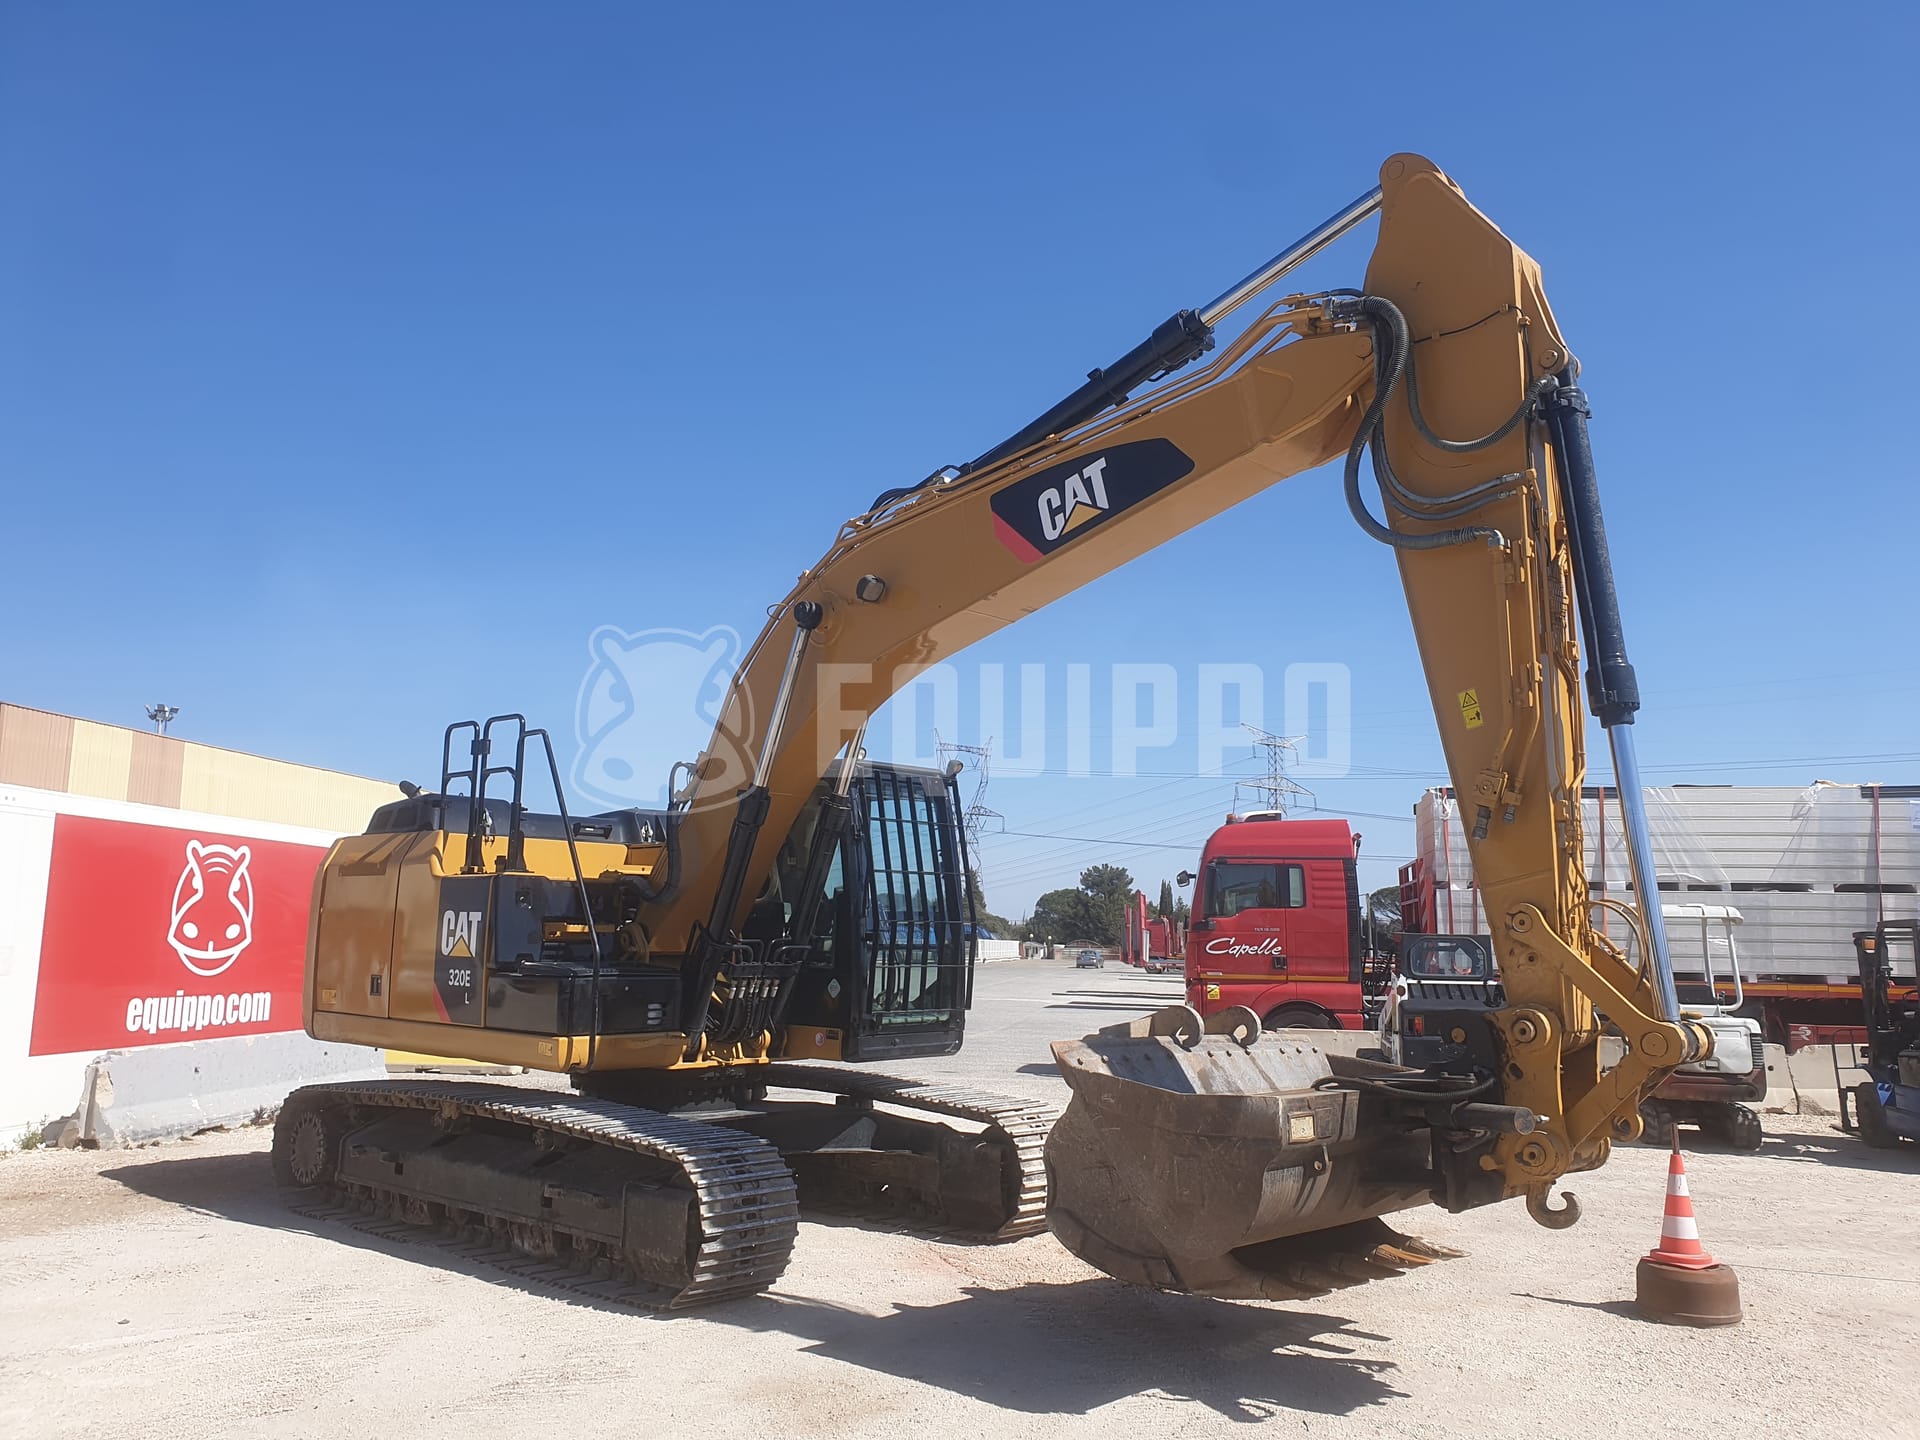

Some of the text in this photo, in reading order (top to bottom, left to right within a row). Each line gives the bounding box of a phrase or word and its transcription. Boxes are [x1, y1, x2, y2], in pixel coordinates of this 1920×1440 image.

[1037, 457, 1110, 541] CAT
[441, 910, 482, 958] CAT
[1205, 937, 1282, 958] Capelle
[448, 968, 471, 987] 320E
[126, 989, 271, 1034] equippo.com
[464, 992, 470, 1004] L
